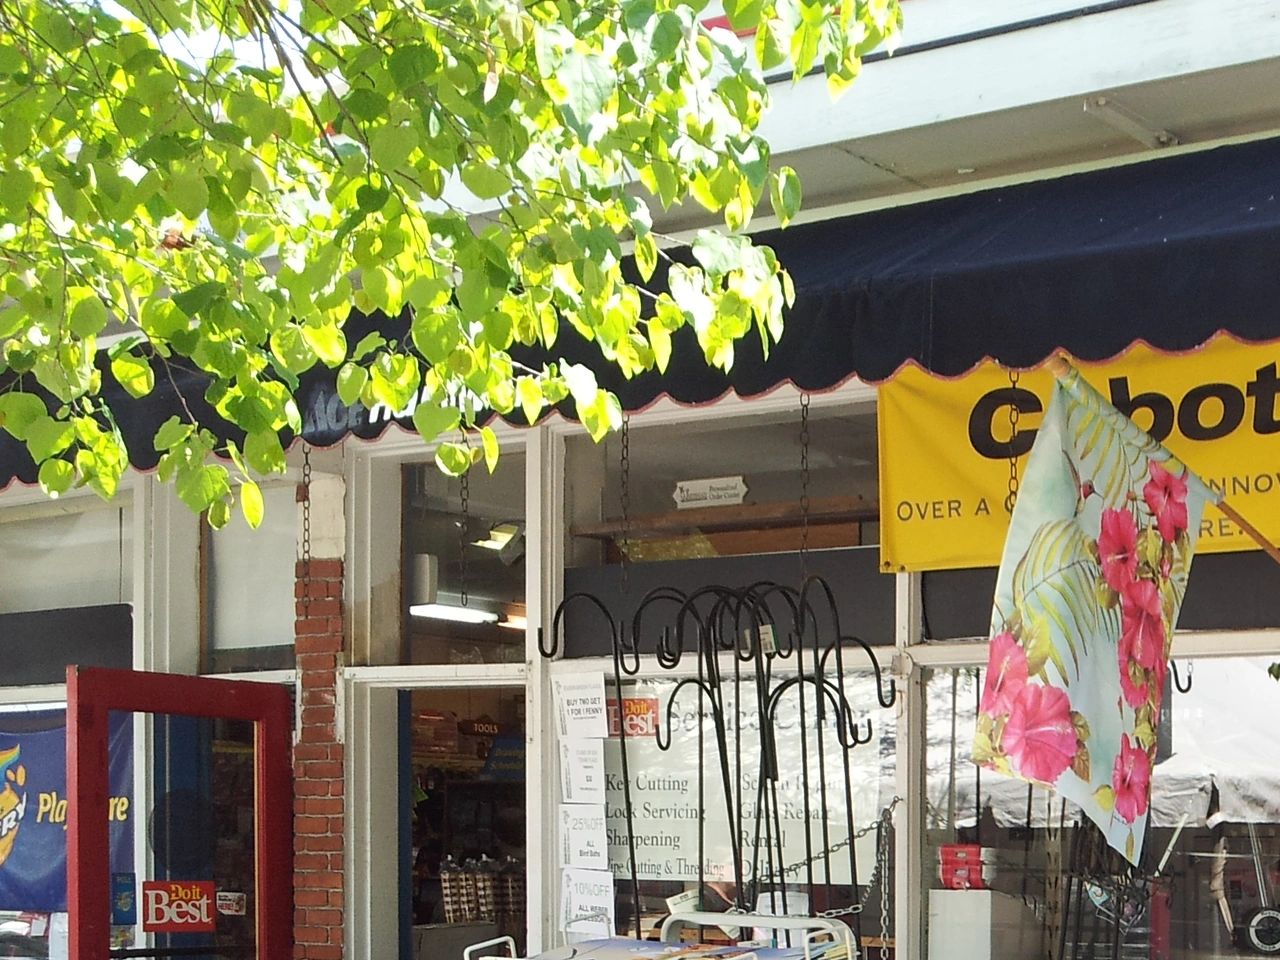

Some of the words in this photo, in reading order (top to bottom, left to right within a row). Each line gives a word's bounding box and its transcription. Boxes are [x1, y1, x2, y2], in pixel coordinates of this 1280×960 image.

[896, 499, 962, 521] OVER
[974, 498, 991, 516] A
[474, 723, 499, 734] TOOLS
[636, 774, 688, 794] Cutting
[36, 791, 68, 831] Pla
[606, 829, 681, 851] Sharpening
[664, 859, 673, 875] &
[676, 858, 725, 877] Threding
[170, 884, 190, 899] Do
[192, 885, 202, 899] it
[145, 889, 213, 925] Best
